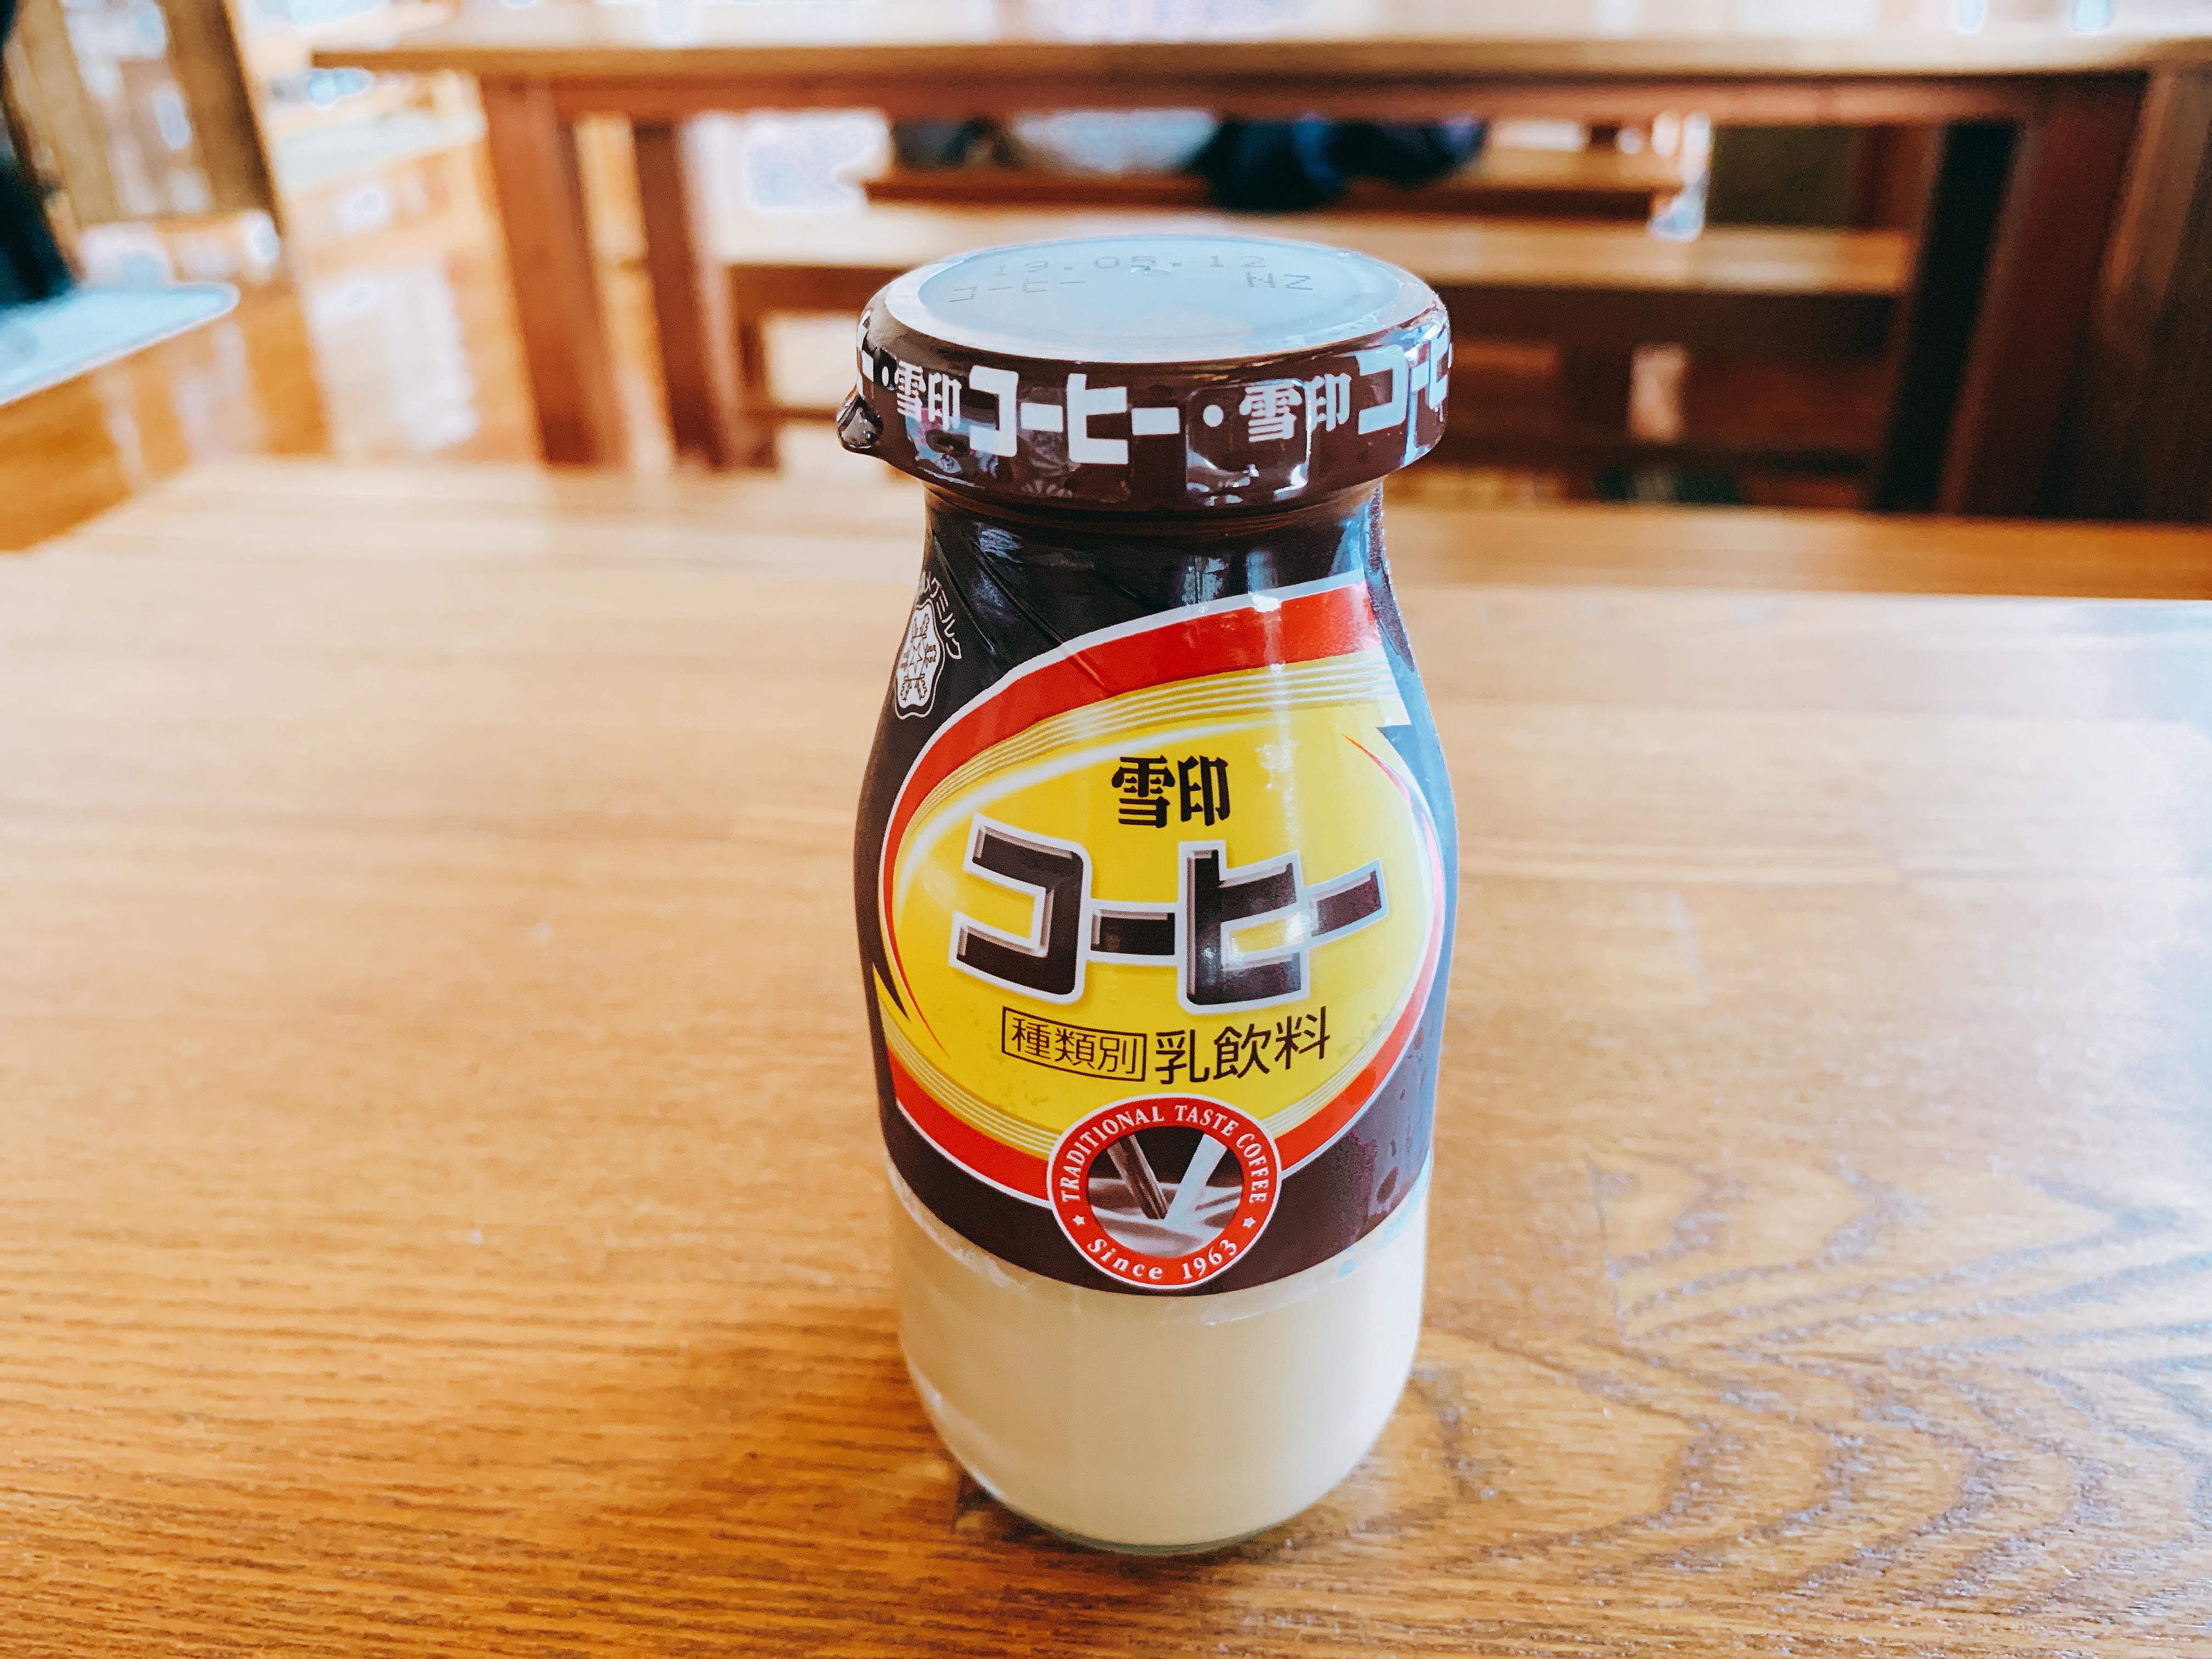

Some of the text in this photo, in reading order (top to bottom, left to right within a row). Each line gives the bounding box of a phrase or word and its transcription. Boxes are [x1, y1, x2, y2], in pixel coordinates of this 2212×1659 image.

[1111, 754, 1232, 828] 雪印
[949, 812, 1389, 1014] コーヒー
[1011, 1006, 1331, 1085] 種類別 乳飲料
[1060, 1104, 1270, 1204] TRADITIONAL TASTE COFFEE
[1087, 1238, 1238, 1280] Since 1963
